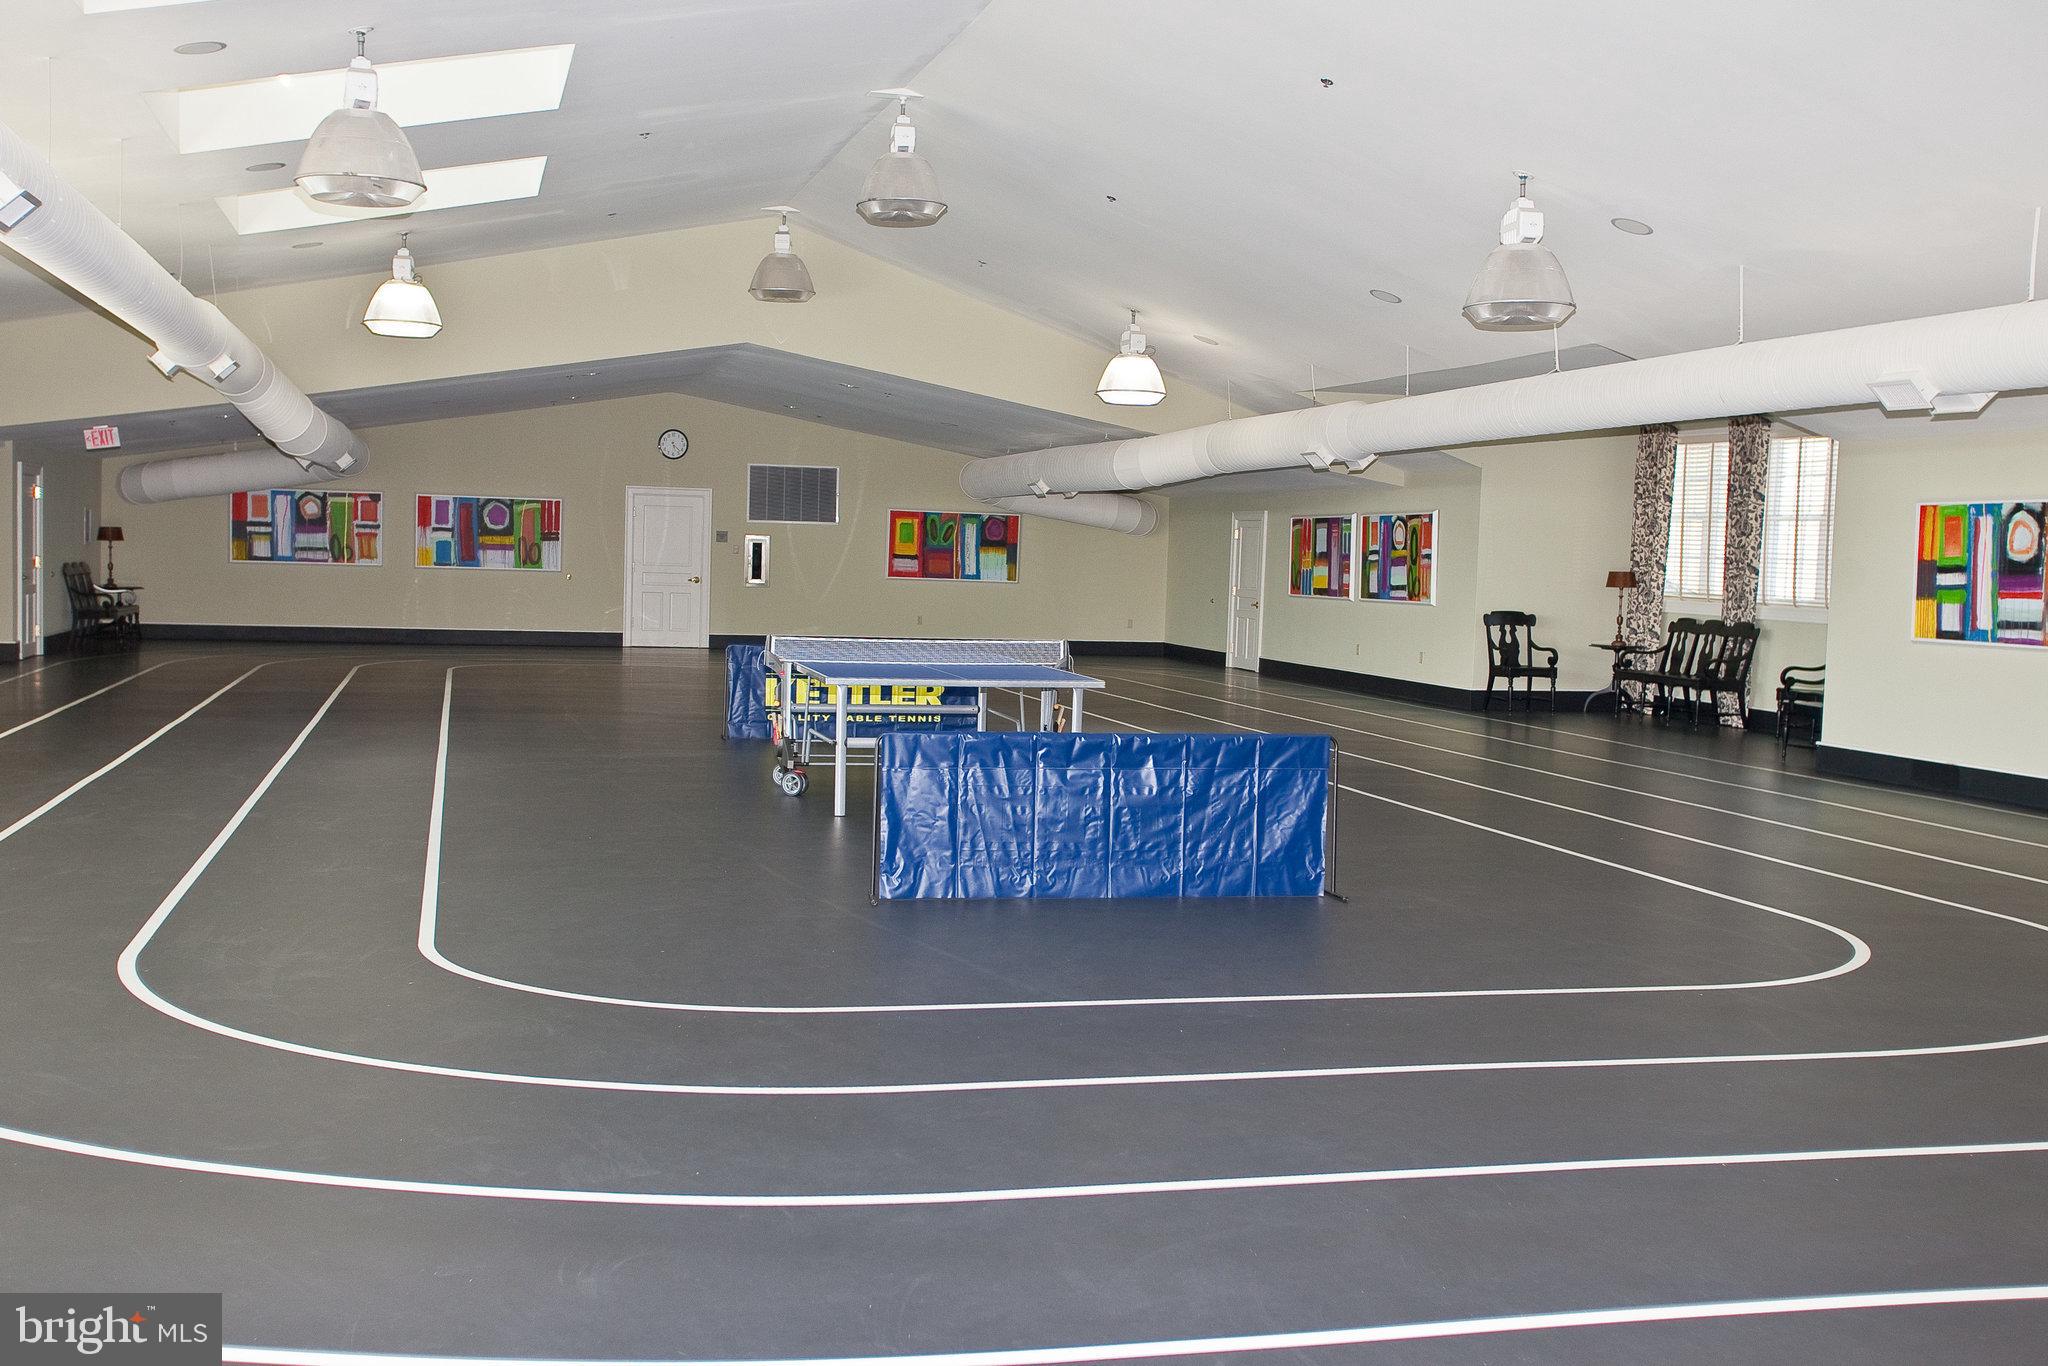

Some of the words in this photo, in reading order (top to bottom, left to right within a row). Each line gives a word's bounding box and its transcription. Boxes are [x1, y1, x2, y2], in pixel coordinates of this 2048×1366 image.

[91, 429, 114, 448] EXIT
[767, 713, 830, 722] QLITY
[842, 714, 882, 722] ABLE
[889, 714, 941, 723] TENNIS
